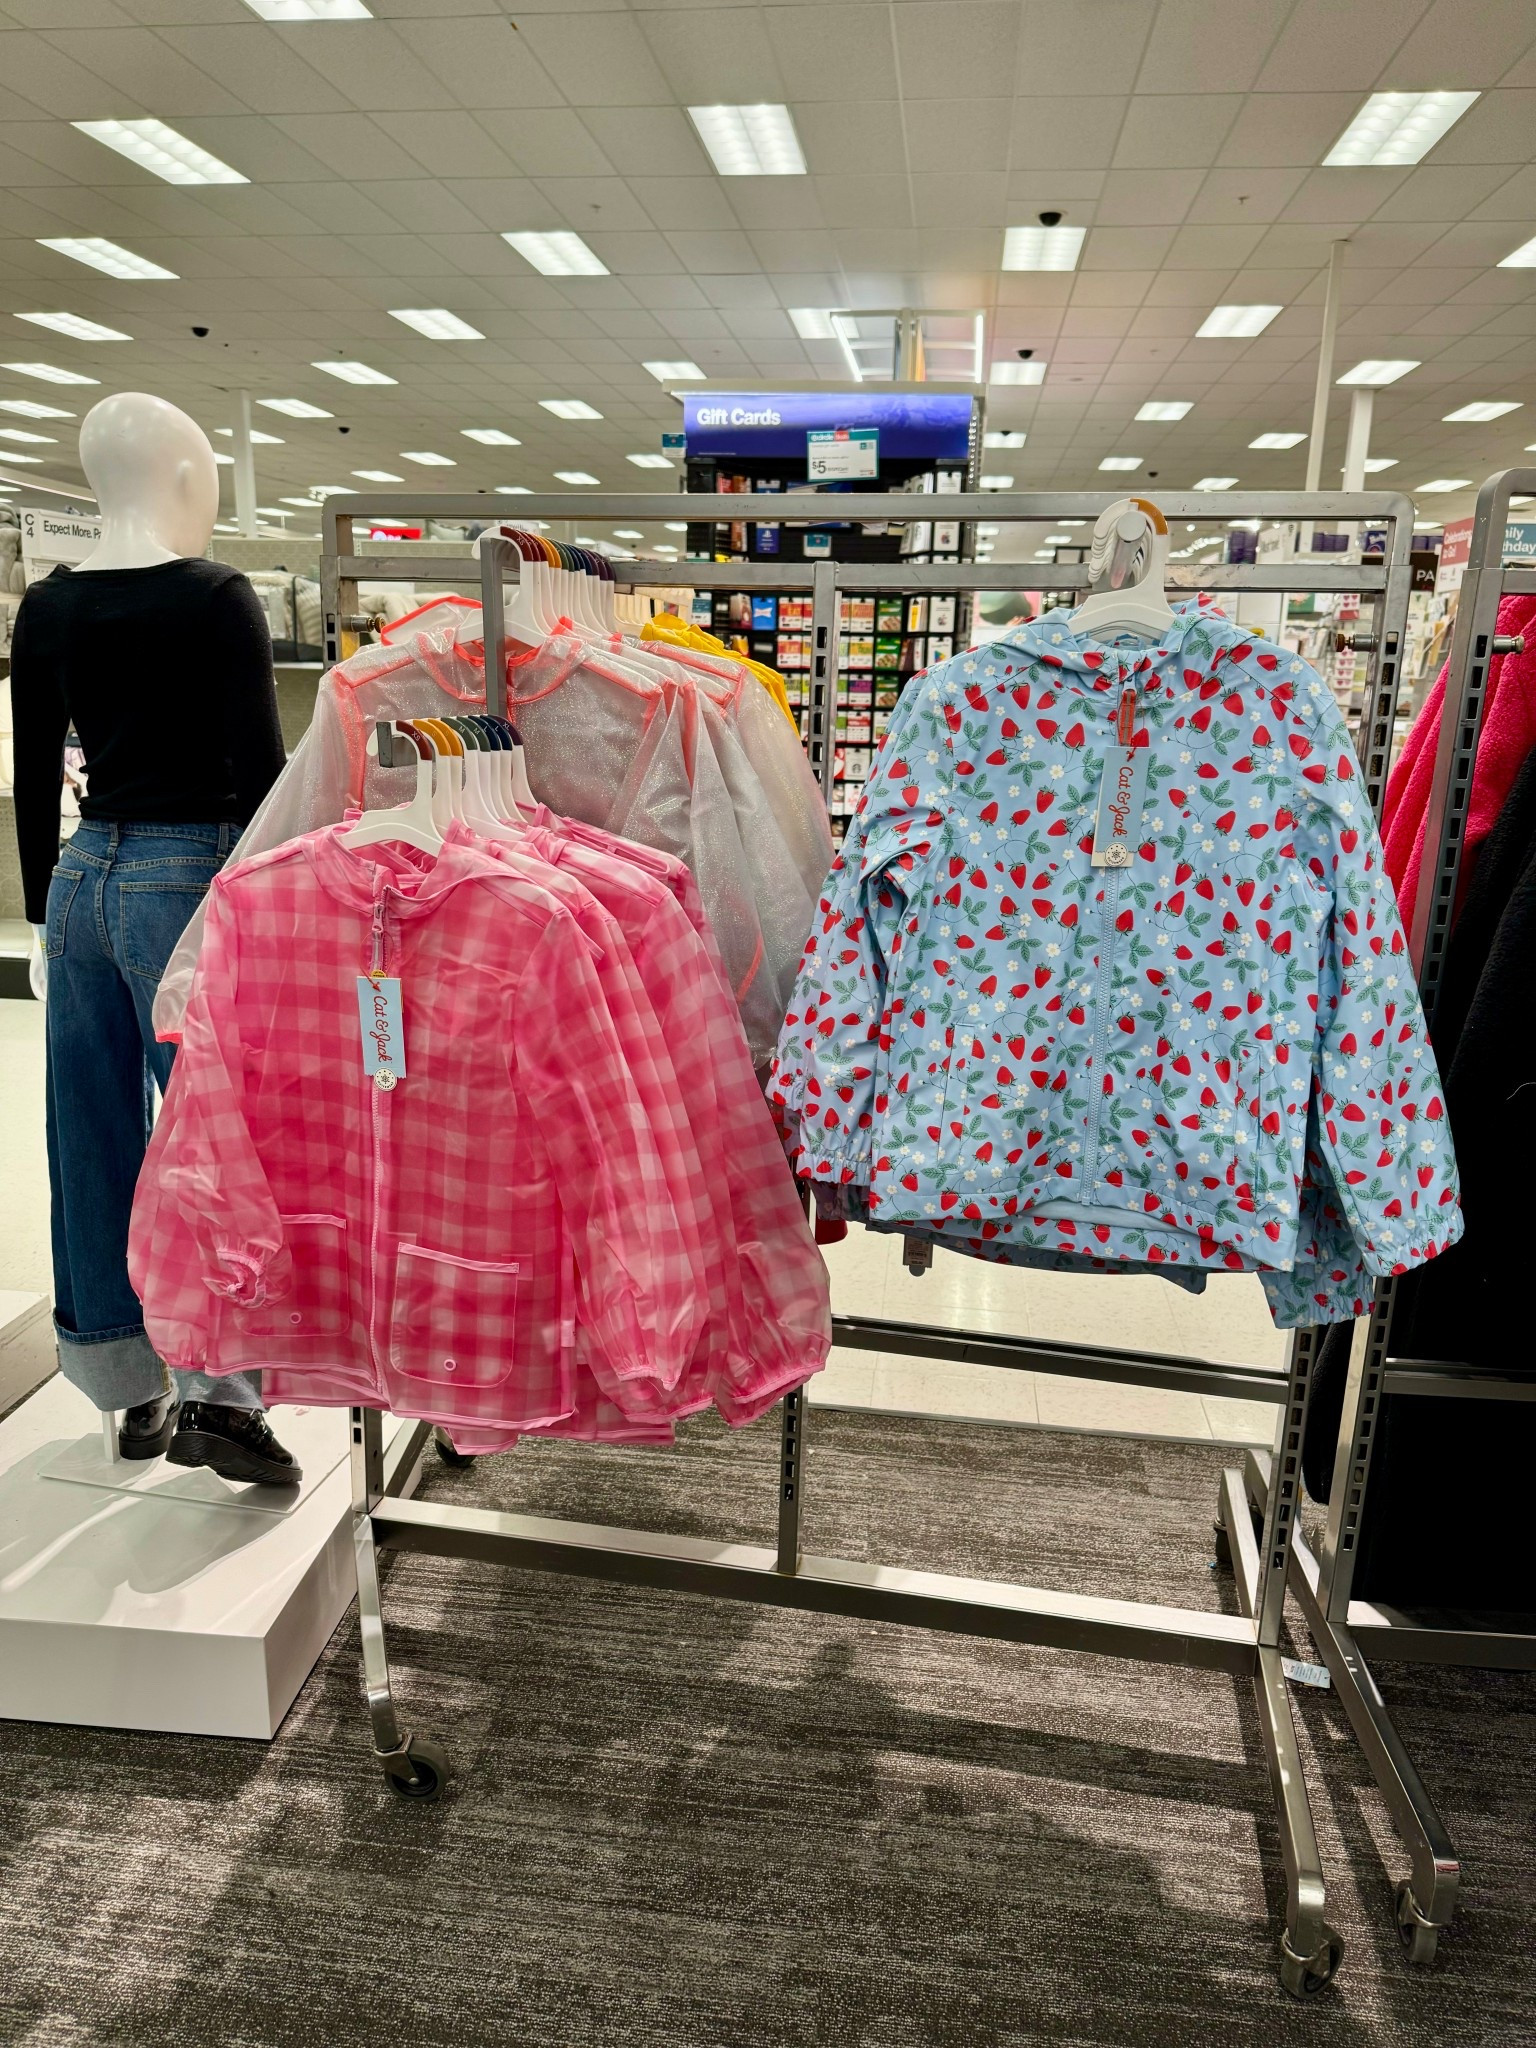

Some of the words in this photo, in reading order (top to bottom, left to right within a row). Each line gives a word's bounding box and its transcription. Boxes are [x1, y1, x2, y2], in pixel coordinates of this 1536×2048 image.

[697, 408, 728, 425] Gift
[731, 408, 781, 425] Cards
[25, 514, 34, 525] C
[27, 527, 34, 538] 4
[44, 521, 70, 535] Expect
[72, 525, 92, 538] More.
[459, 726, 465, 734] M
[503, 722, 510, 730] XL
[412, 731, 420, 741] XS
[1118, 766, 1133, 789] Cat
[1117, 792, 1131, 805] &
[1109, 804, 1130, 838] Jack
[374, 996, 388, 1017] Cat
[376, 1020, 388, 1032] &
[370, 1031, 392, 1062] Jack
